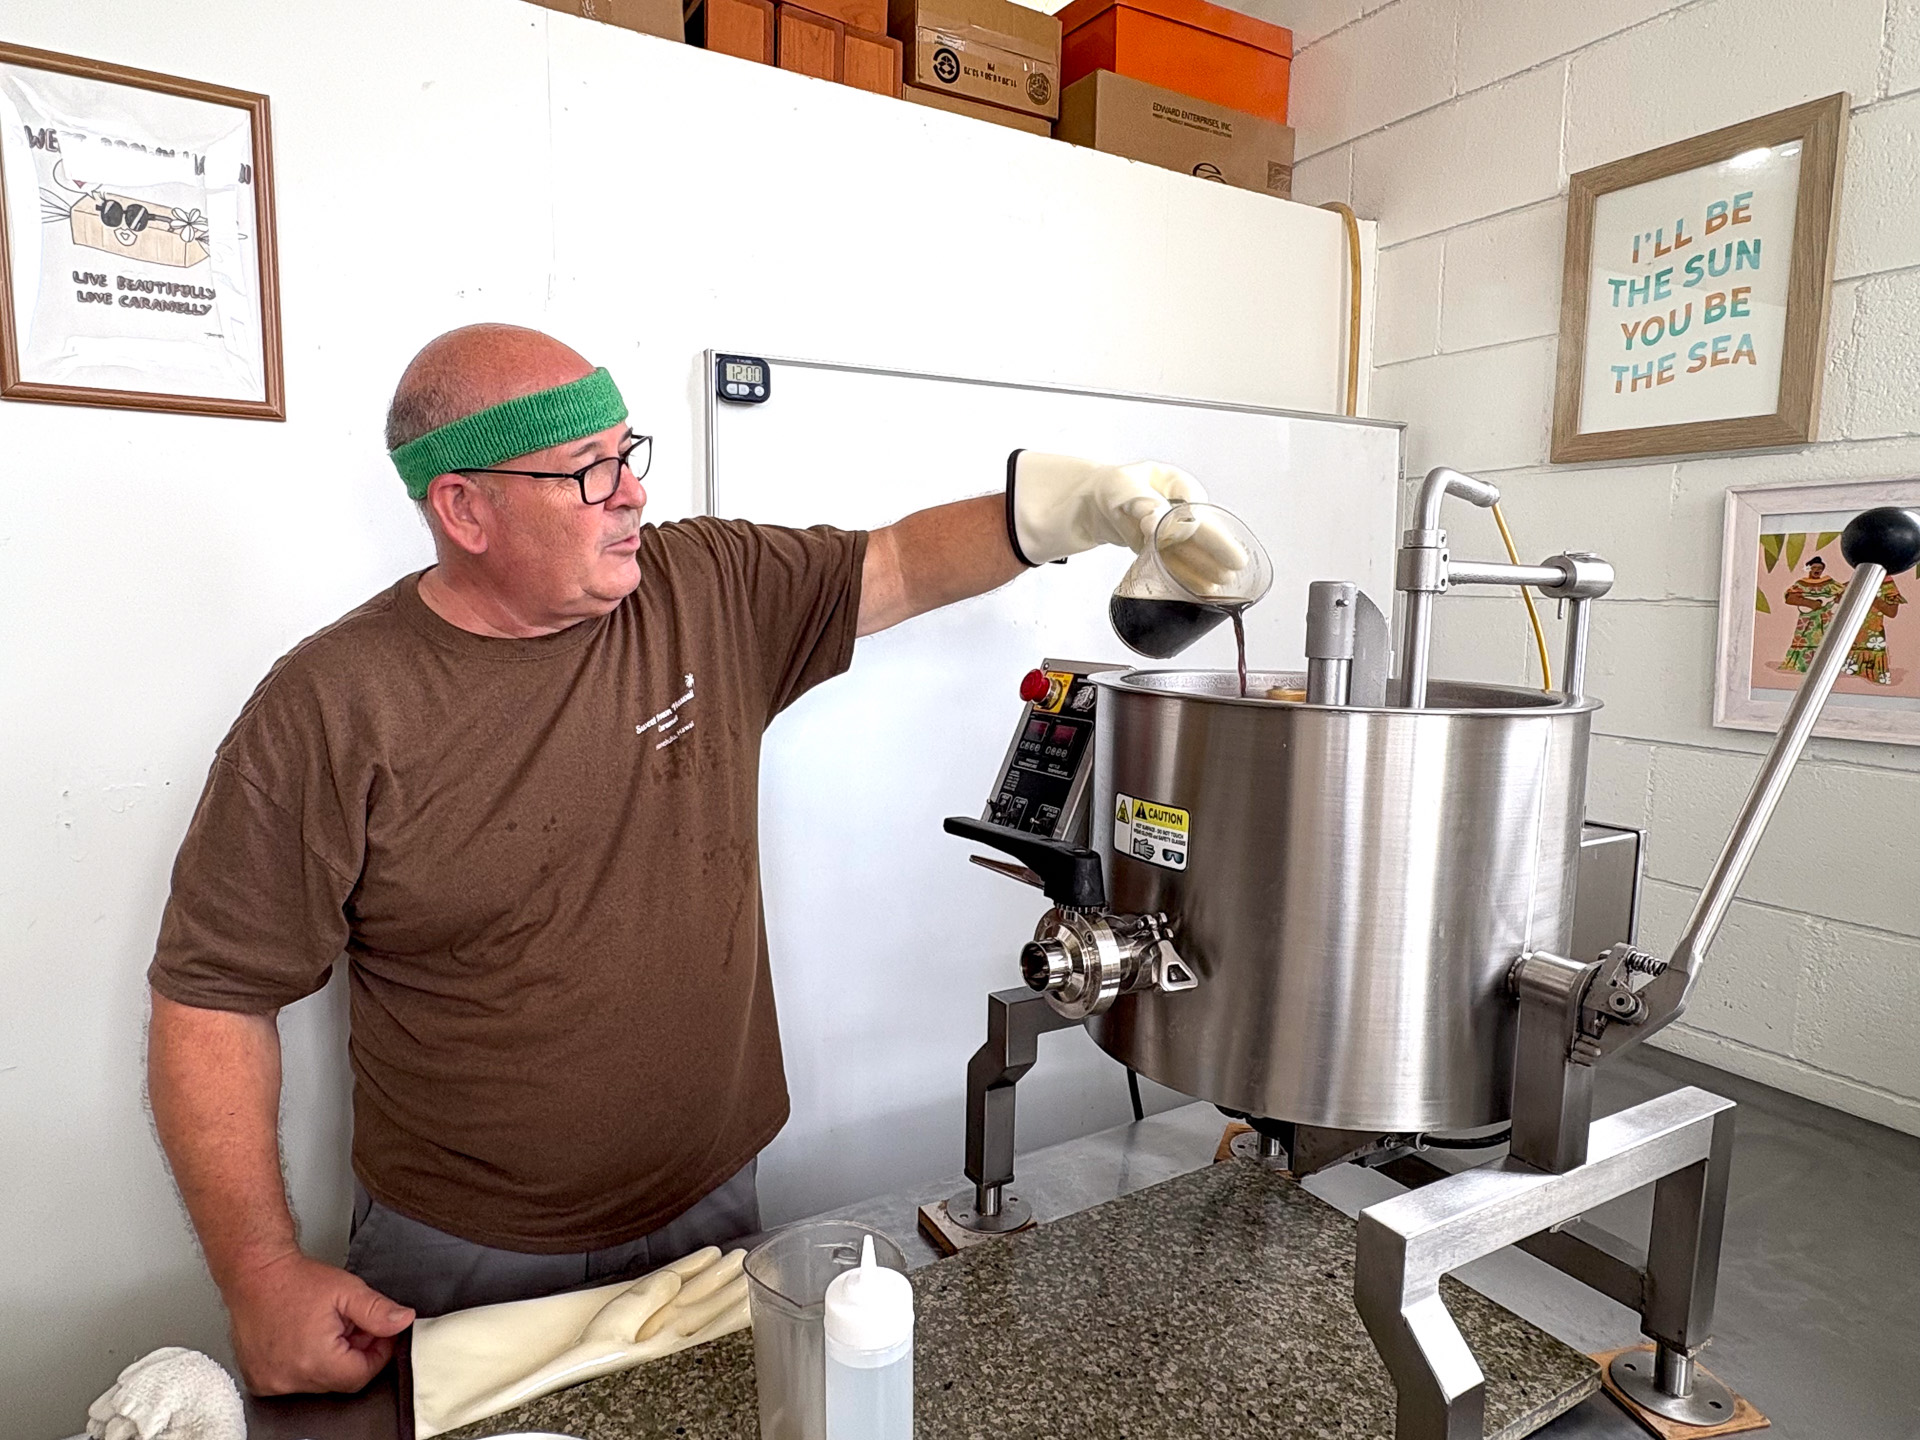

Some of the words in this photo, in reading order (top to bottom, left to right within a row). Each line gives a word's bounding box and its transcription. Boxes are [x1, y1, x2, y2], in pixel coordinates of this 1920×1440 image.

[1152, 102, 1181, 118] EDWARD
[1181, 110, 1220, 130] ENTERPRISES,
[1631, 218, 1693, 264] I'LL
[1704, 191, 1754, 236] BE
[72, 270, 108, 288] LIVE
[116, 275, 217, 301] BEAUTIFULLY
[1607, 266, 1674, 308] THE
[1682, 238, 1762, 288] SUN
[76, 290, 113, 305] LOVE
[118, 294, 213, 316] CARAMELLY
[1620, 302, 1693, 351] YOU
[1703, 286, 1752, 325] BE
[732, 365, 761, 383] 12:00
[1610, 352, 1676, 394] THE
[1686, 333, 1757, 374] SEA
[1148, 807, 1183, 826] CAUTION
